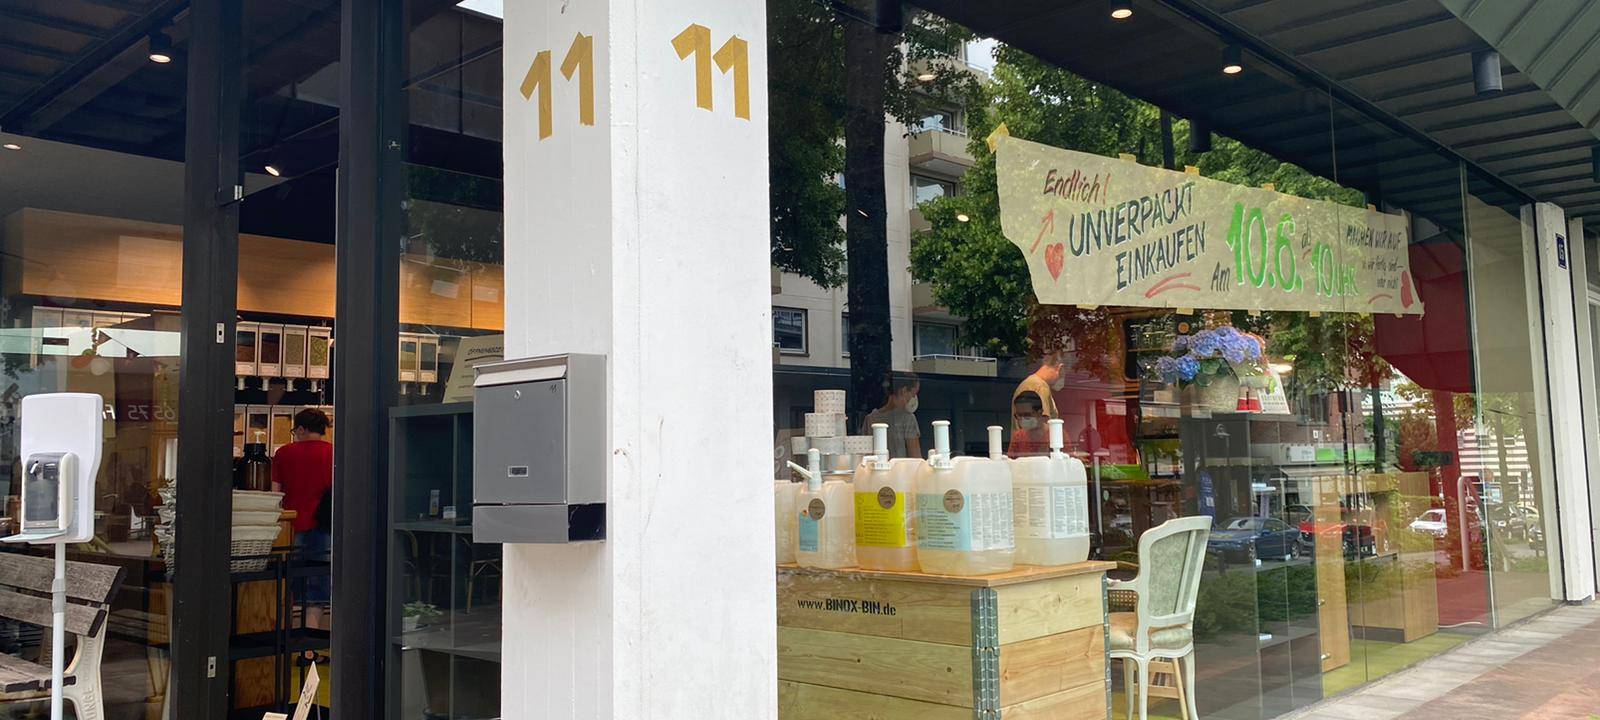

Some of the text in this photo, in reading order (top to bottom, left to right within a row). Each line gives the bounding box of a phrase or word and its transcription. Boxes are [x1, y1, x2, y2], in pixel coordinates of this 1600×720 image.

[519, 31, 595, 141] 11
[670, 23, 752, 122] 11
[1043, 168, 1112, 205] Endlich!
[1068, 180, 1197, 258] UNVERPACKT
[1114, 220, 1206, 292] EINKAUFEN
[1210, 261, 1231, 293] Am
[1226, 201, 1304, 293] 10.6.
[797, 598, 896, 616] www.BINOX-BIN.de
